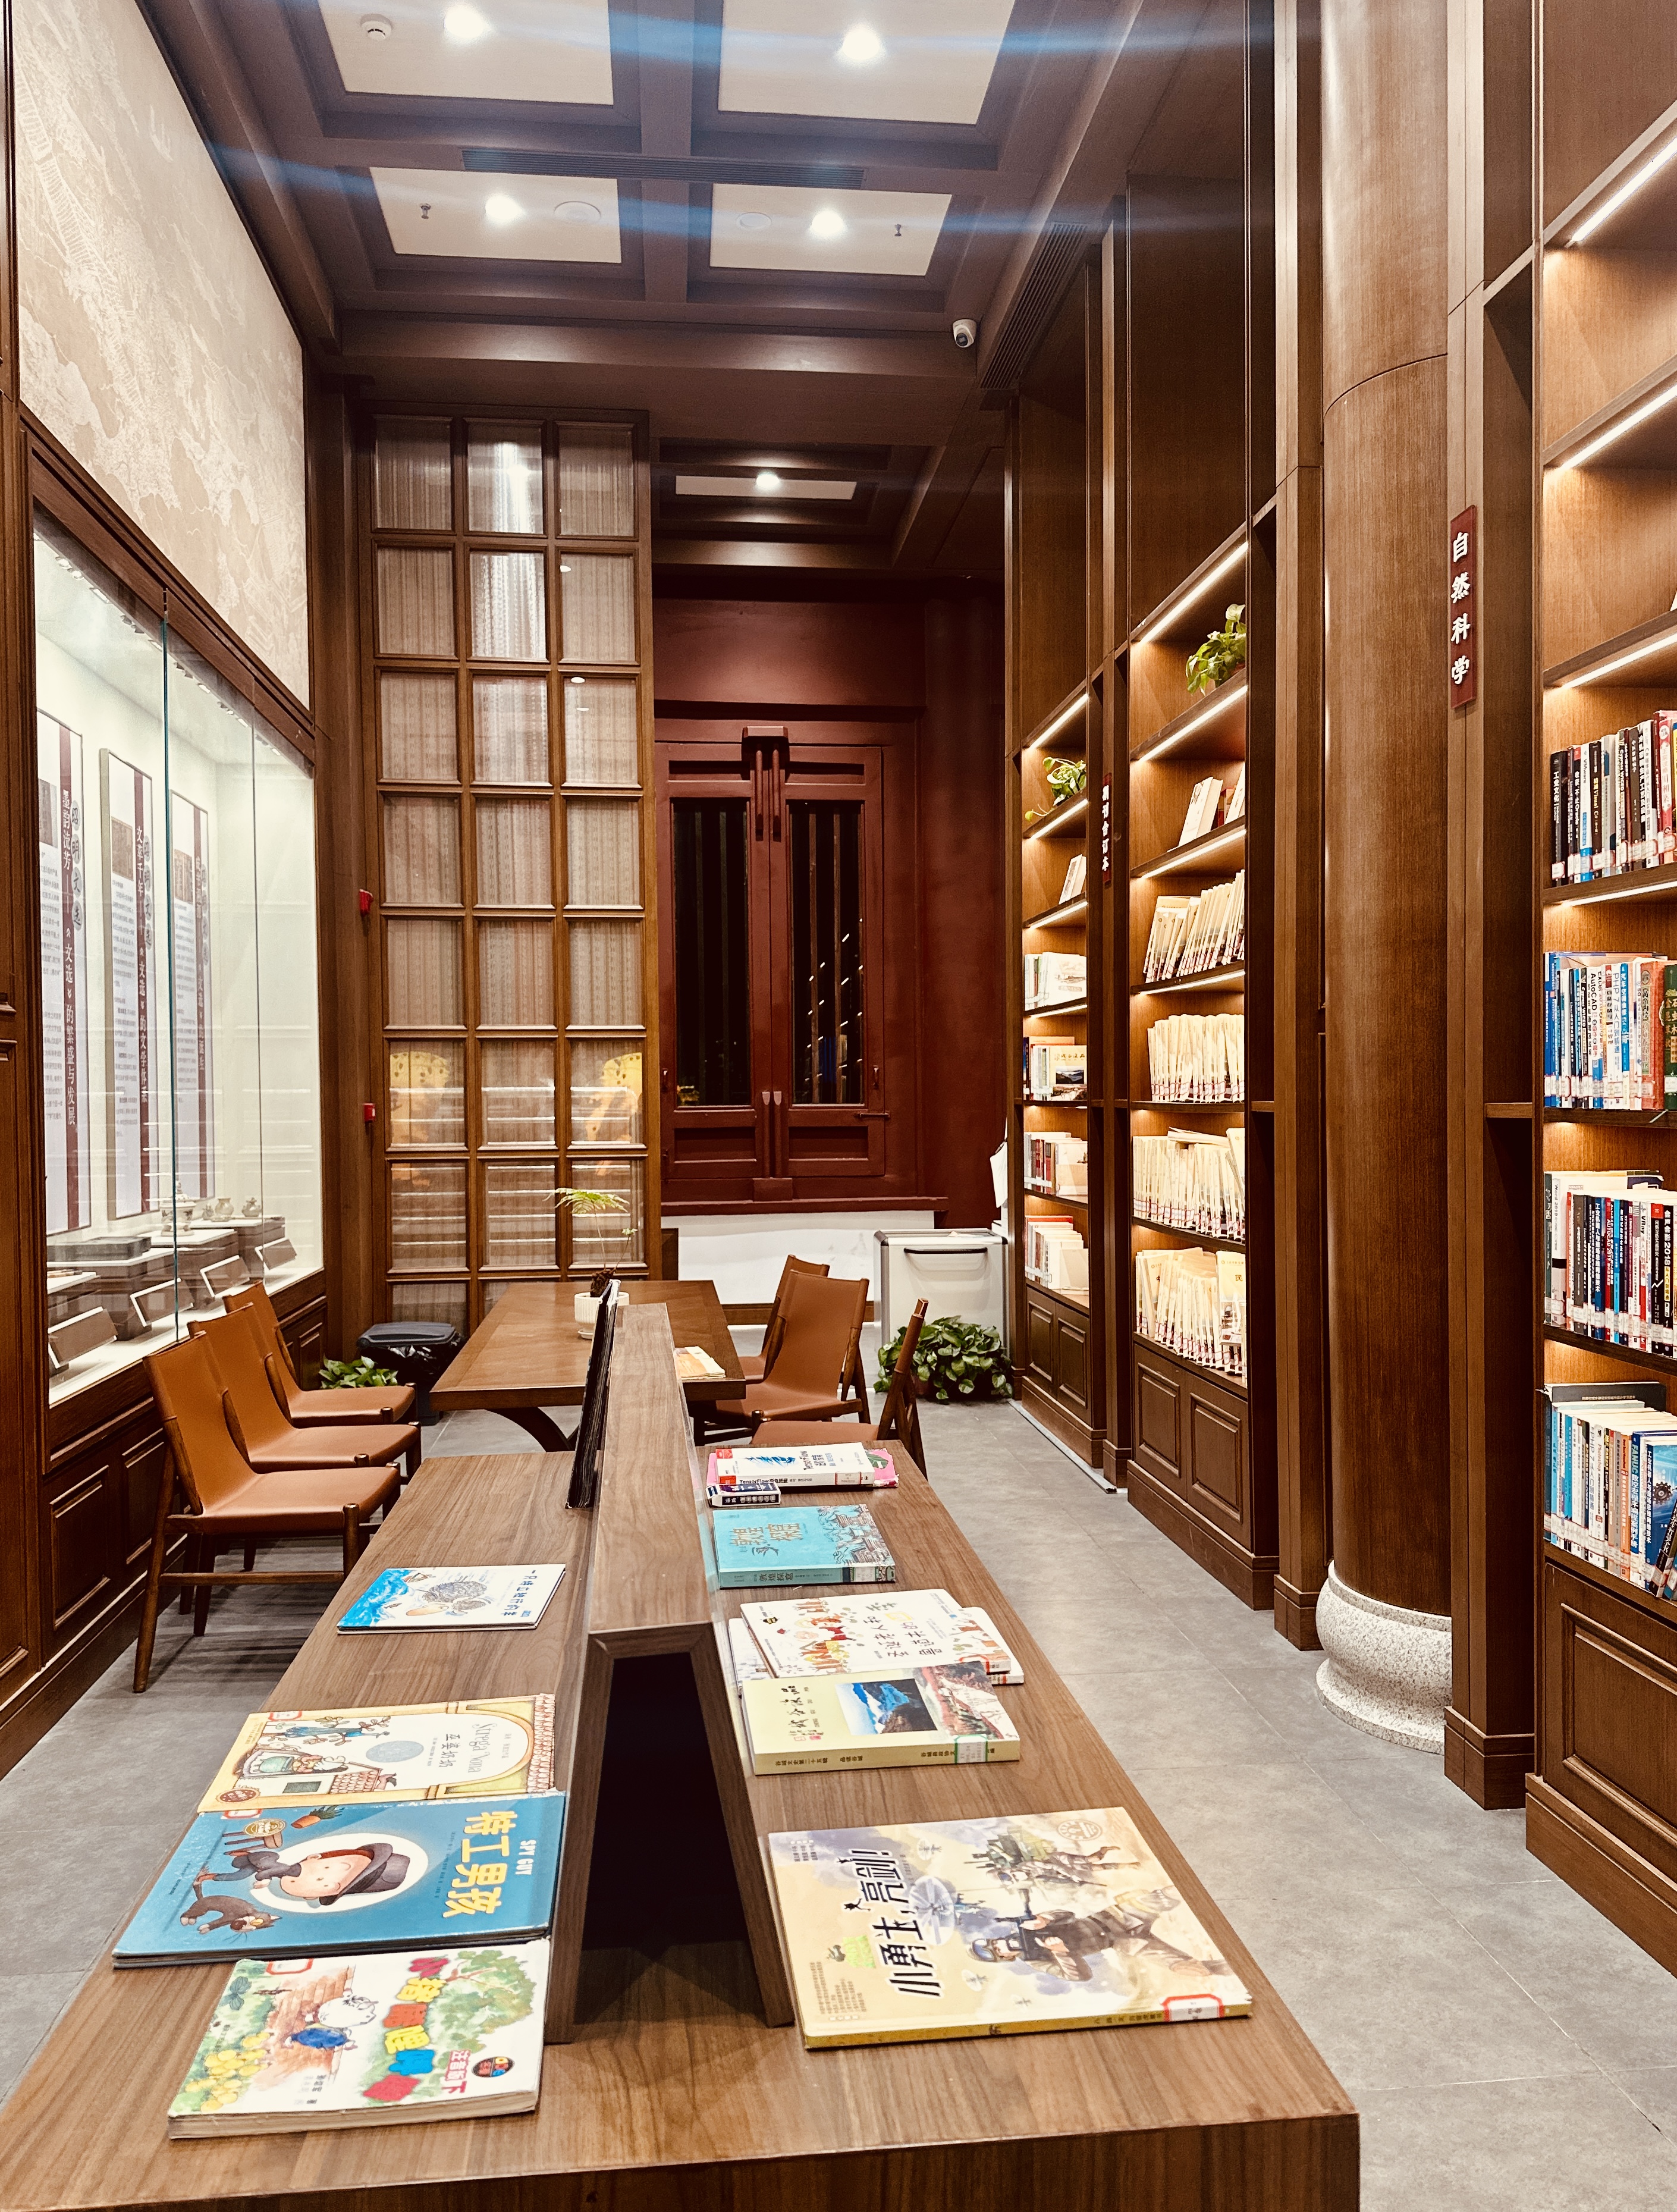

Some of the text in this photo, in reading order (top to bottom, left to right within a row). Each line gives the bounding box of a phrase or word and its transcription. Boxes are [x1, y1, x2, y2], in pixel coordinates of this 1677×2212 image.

[1451, 532, 1471, 685] 自然科学
[71, 806, 82, 927] 昭明文选
[144, 839, 153, 948] 昭明文选
[863, 1615, 909, 1658] 圣诞老人和
[439, 1733, 460, 1768] 巫婆奶奶
[469, 1723, 497, 1752] Strega
[442, 1811, 518, 1919] 特工男孩
[514, 1840, 537, 1875] SPY GUY
